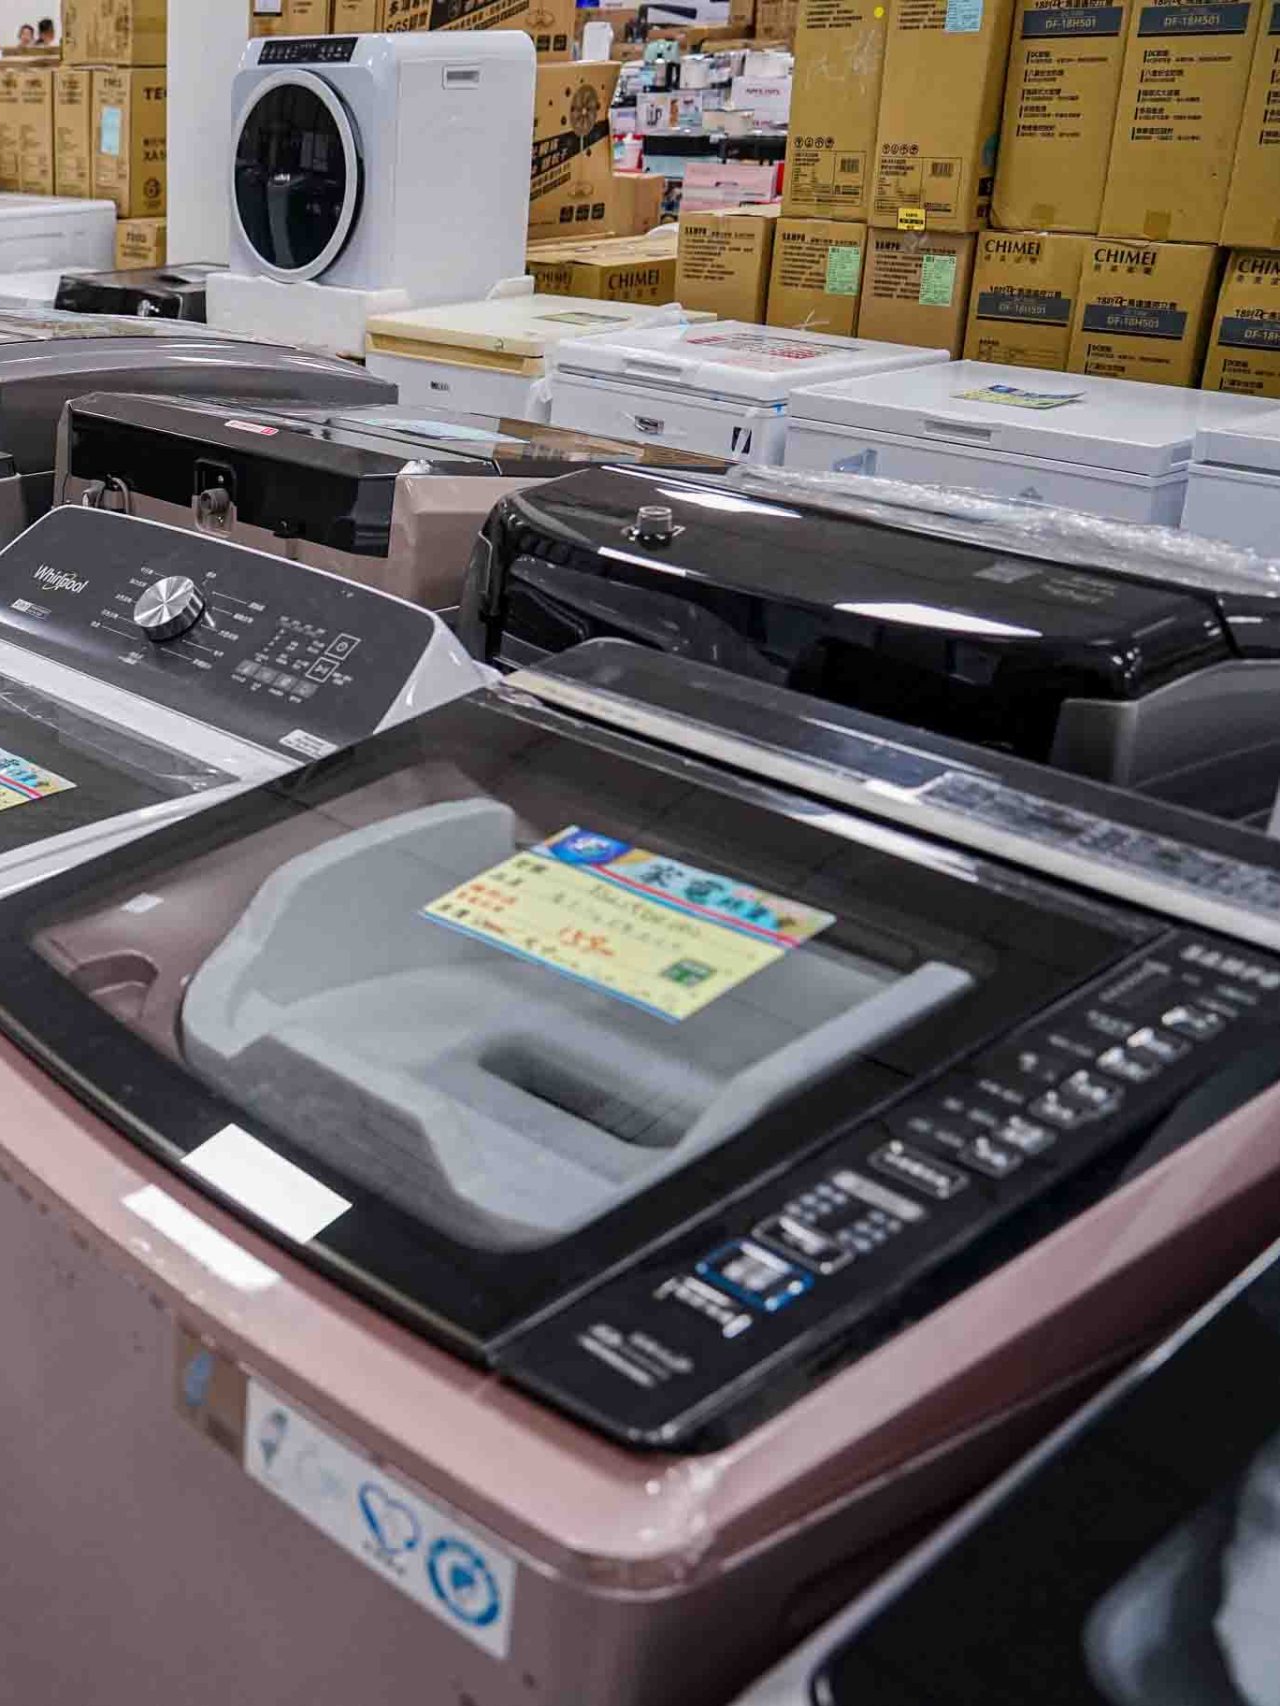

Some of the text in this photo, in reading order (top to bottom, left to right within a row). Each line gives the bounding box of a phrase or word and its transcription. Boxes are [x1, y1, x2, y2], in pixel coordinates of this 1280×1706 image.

[1046, 17, 1097, 29] DF-18H501
[1164, 15, 1220, 27] DF-18H501
[984, 239, 1041, 255] CHIMEI
[1094, 248, 1157, 265] CHIMEI
[608, 268, 660, 290] CHIMEI
[33, 563, 90, 593] Whirlpool
